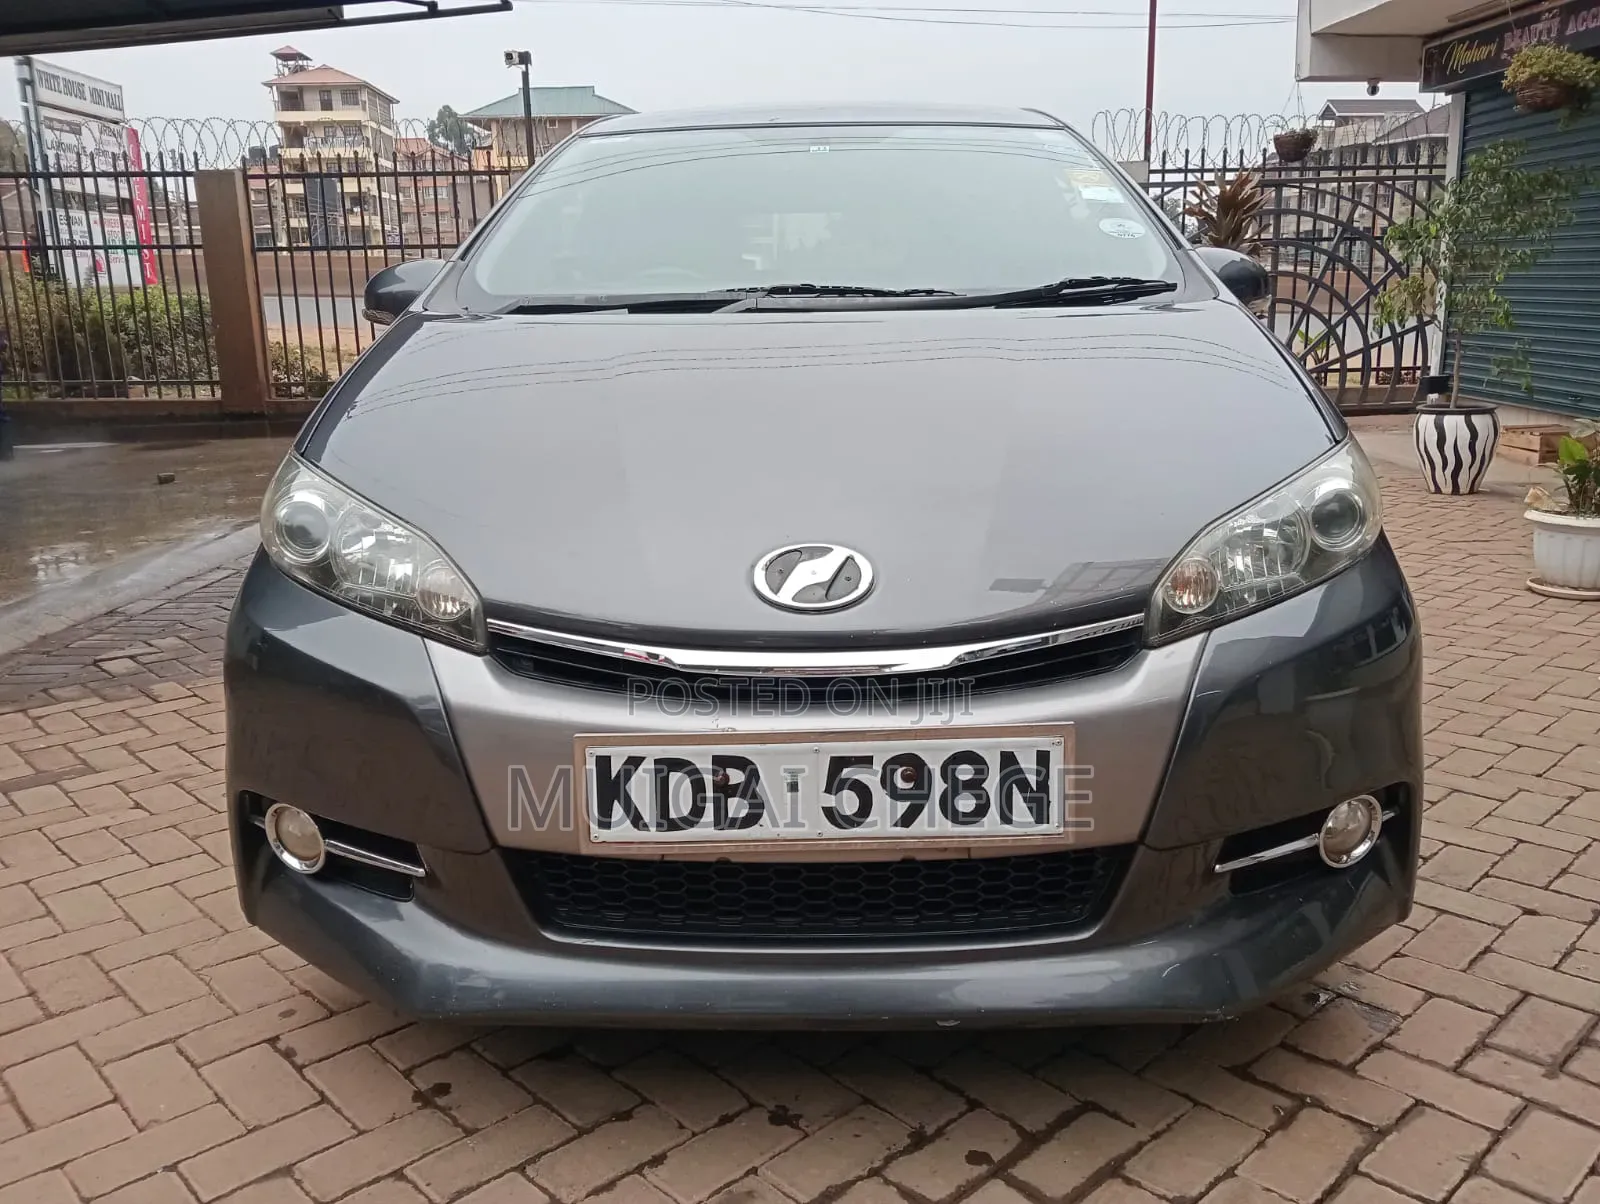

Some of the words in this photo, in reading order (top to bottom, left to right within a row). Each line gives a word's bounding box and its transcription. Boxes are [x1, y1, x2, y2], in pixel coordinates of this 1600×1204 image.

[1503, 17, 1561, 51] BEAUTY
[1565, 6, 1600, 36] ACC
[1443, 38, 1499, 75] Mahari
[36, 68, 62, 94] WHITE
[62, 77, 87, 101] HOUSE
[88, 86, 105, 107] MINI
[104, 90, 123, 111] MALL
[595, 754, 765, 833] KDB
[821, 750, 1051, 830] 598N
